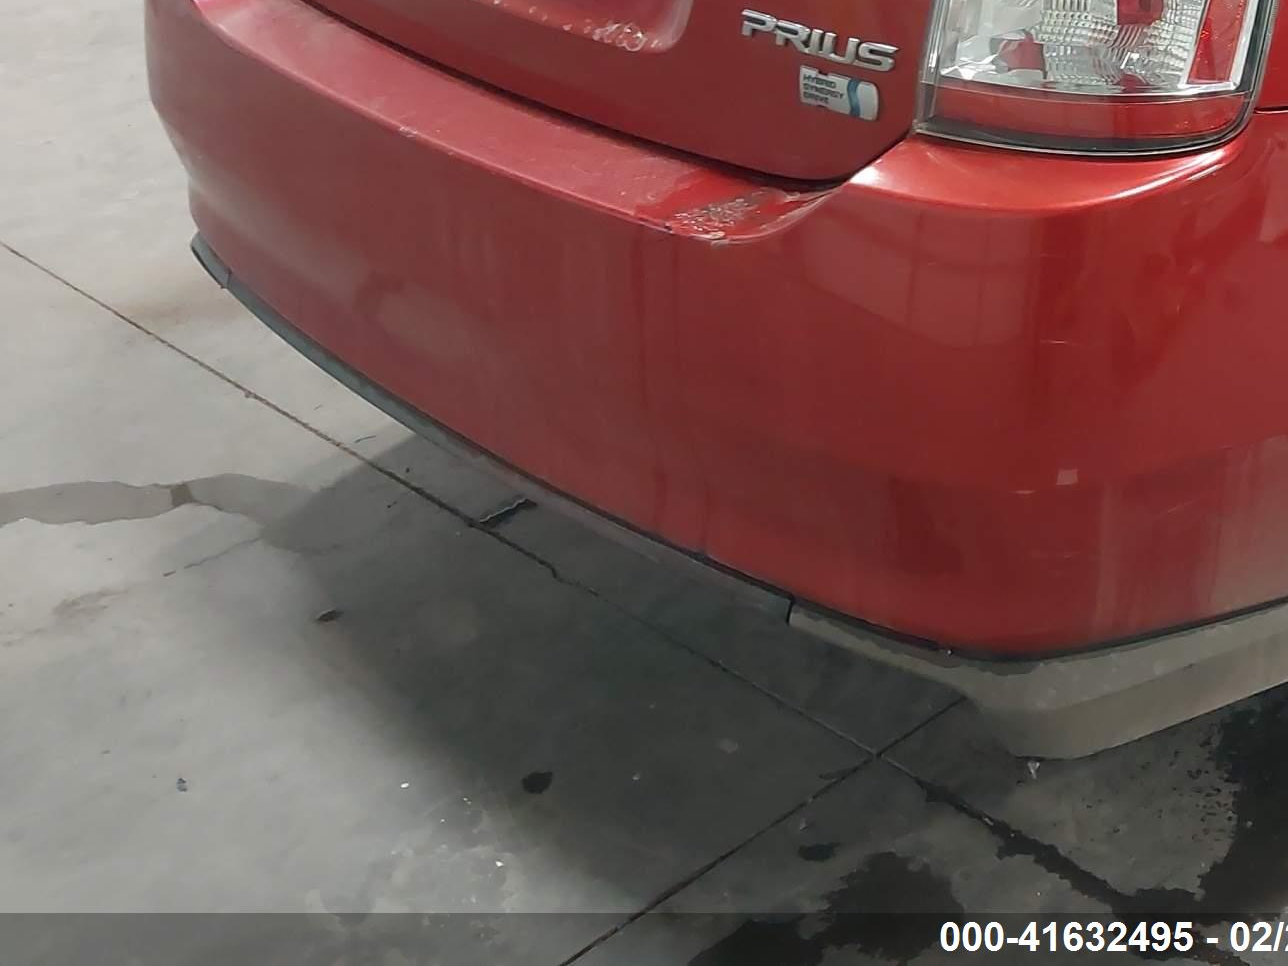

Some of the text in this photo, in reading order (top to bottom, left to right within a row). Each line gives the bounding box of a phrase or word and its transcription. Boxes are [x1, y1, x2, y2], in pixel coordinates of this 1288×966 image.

[741, 9, 899, 72] PRIUS
[803, 73, 837, 89] HYBRID
[803, 82, 844, 99] SYNERGY
[803, 90, 829, 104] DRIVE
